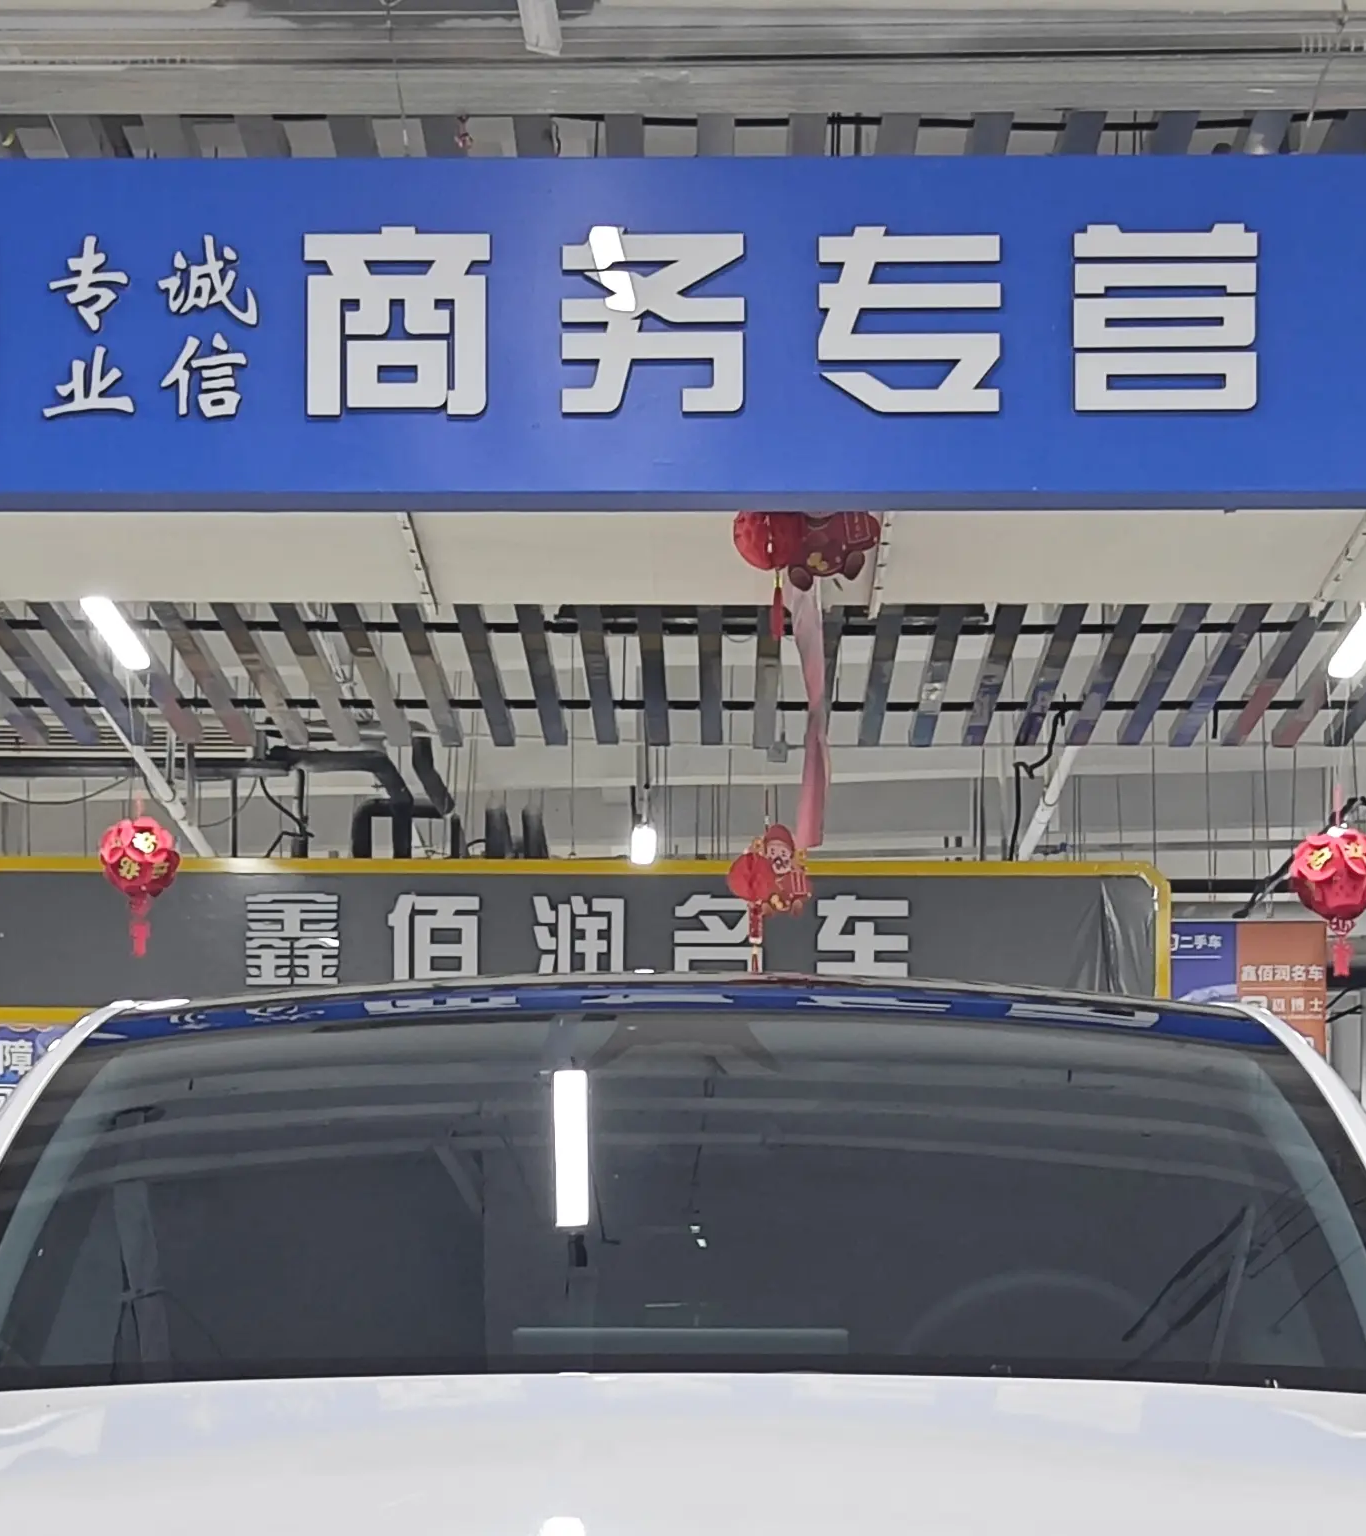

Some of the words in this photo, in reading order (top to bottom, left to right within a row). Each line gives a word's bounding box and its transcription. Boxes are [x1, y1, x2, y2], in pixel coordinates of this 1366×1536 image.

[303, 223, 1259, 417] 商务专营
[245, 893, 910, 987] 鑫佰润名车
